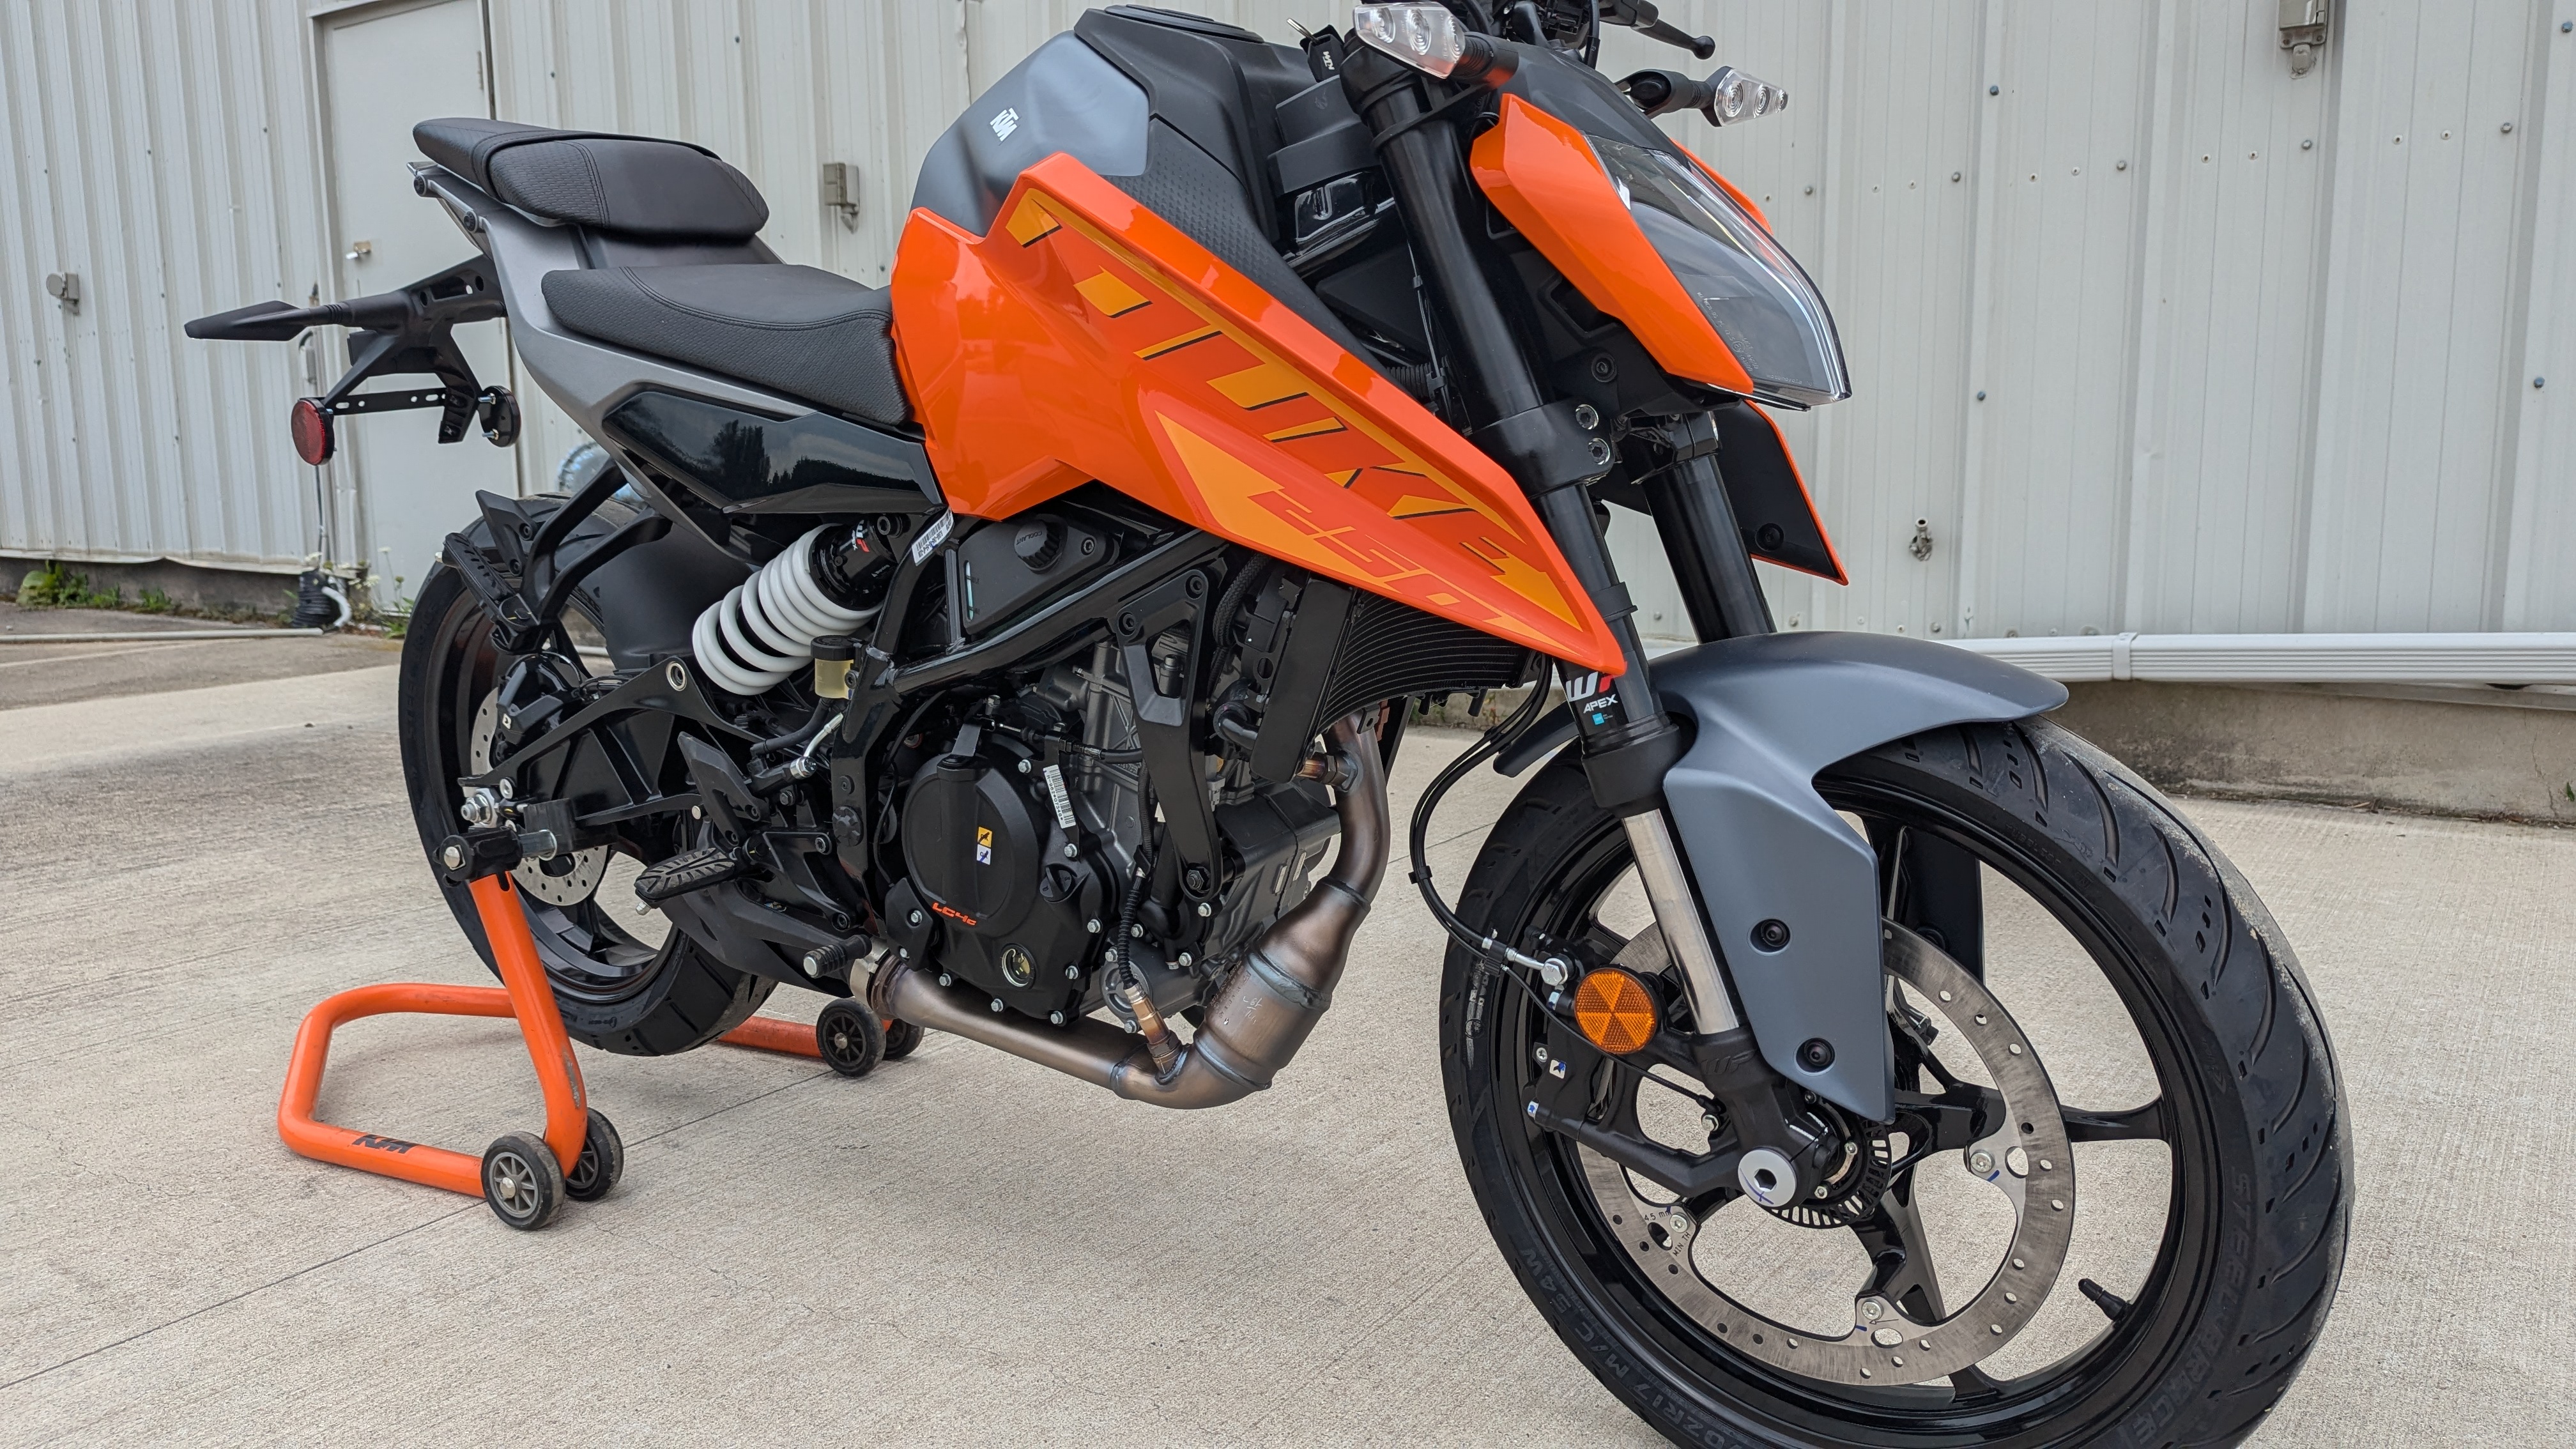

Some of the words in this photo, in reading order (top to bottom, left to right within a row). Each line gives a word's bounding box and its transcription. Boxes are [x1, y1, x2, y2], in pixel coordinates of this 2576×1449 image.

[1322, 51, 1335, 70] KTM
[990, 107, 1019, 141] KTM
[1023, 199, 1546, 576] DUKE
[1016, 531, 1043, 546] COOLANT
[1247, 488, 1502, 620] 250
[1583, 694, 1618, 714] APEX
[1701, 1049, 1756, 1075] WP
[351, 1134, 420, 1154] KTM
[1644, 1213, 1656, 1221] 4.5
[1520, 1248, 1572, 1314] 54W
[1574, 1321, 1630, 1379] M/C
[1632, 1382, 1743, 1449] 0ZR17
